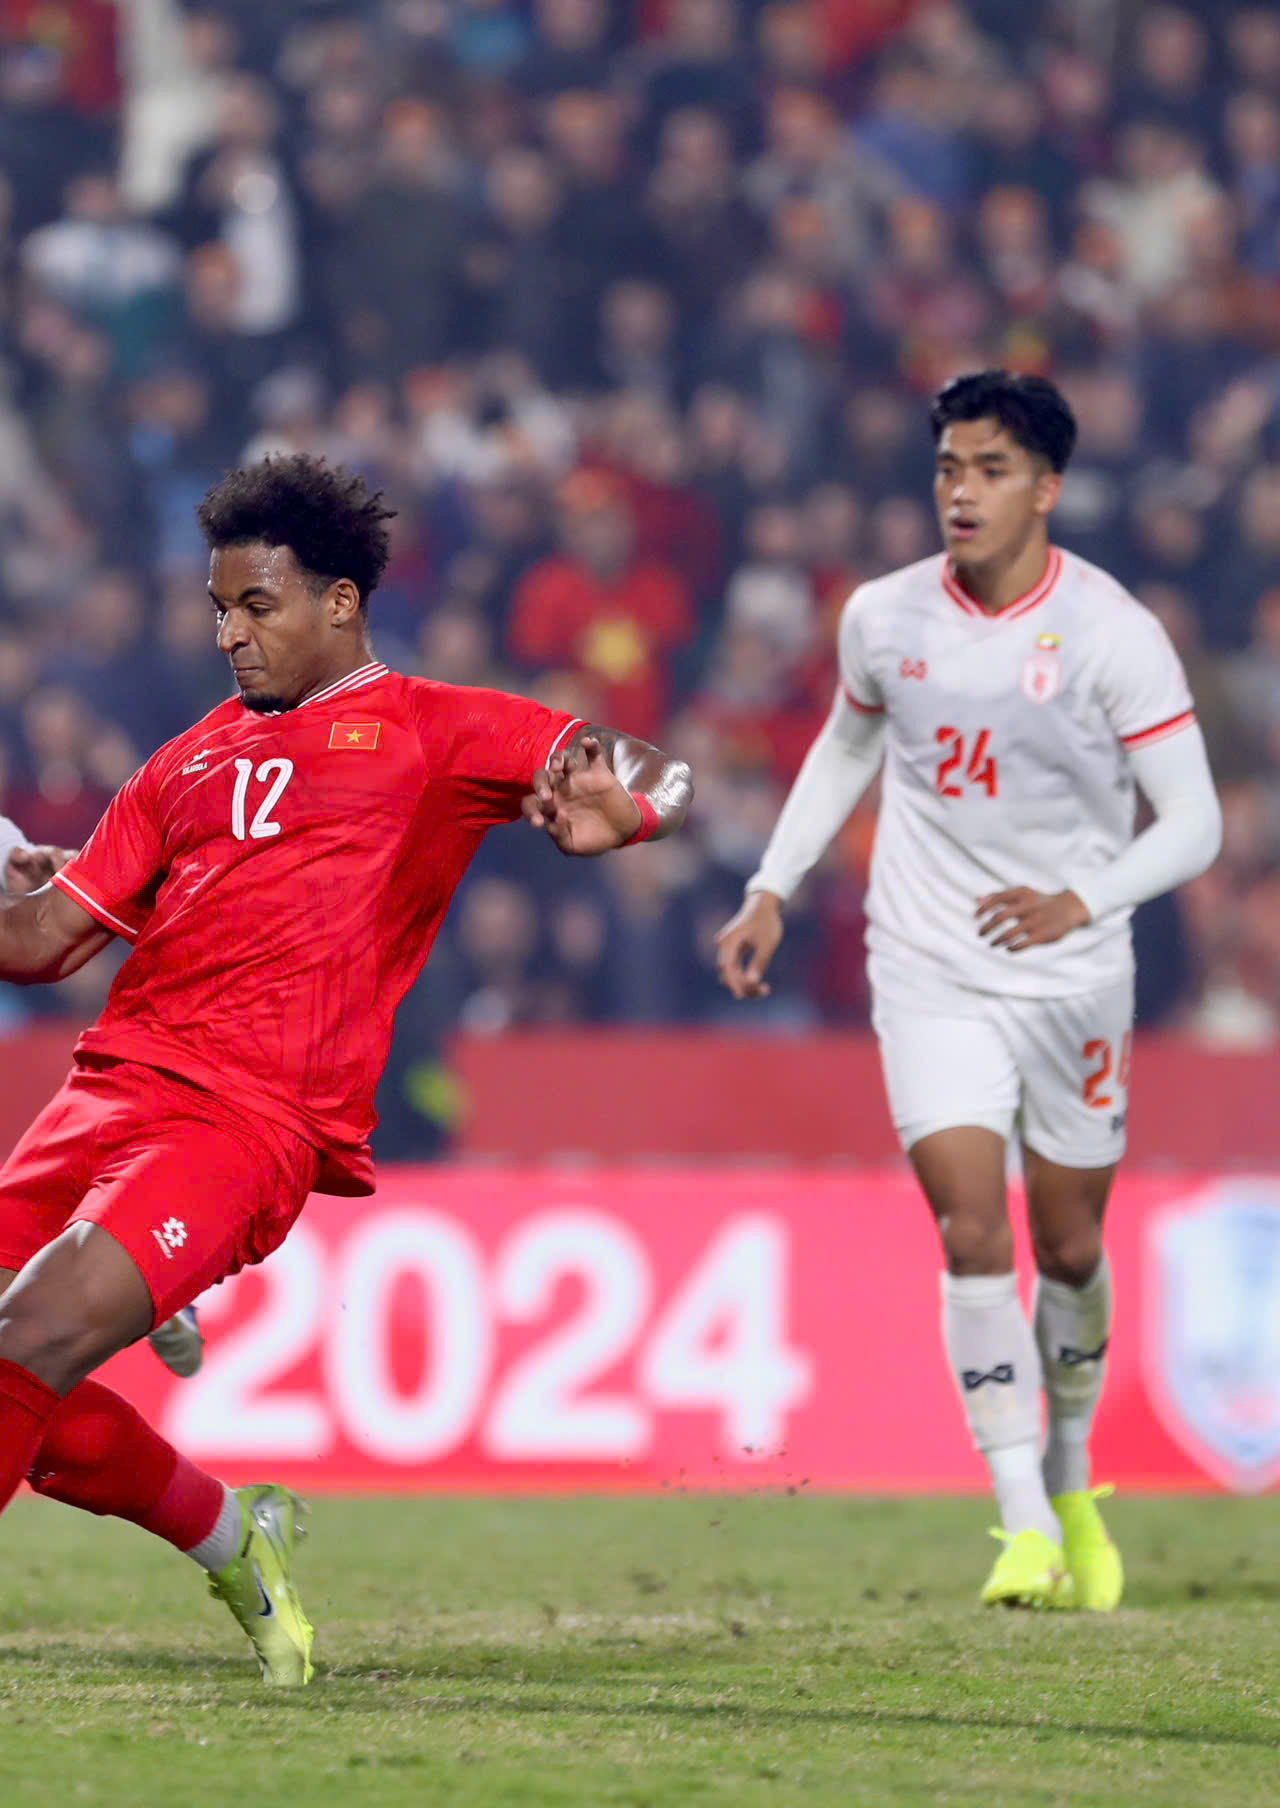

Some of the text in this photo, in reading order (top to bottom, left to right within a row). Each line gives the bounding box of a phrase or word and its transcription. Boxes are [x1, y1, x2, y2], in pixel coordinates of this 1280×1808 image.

[231, 758, 294, 840] 12
[934, 726, 997, 798] 24
[170, 1205, 814, 1463] 2024
